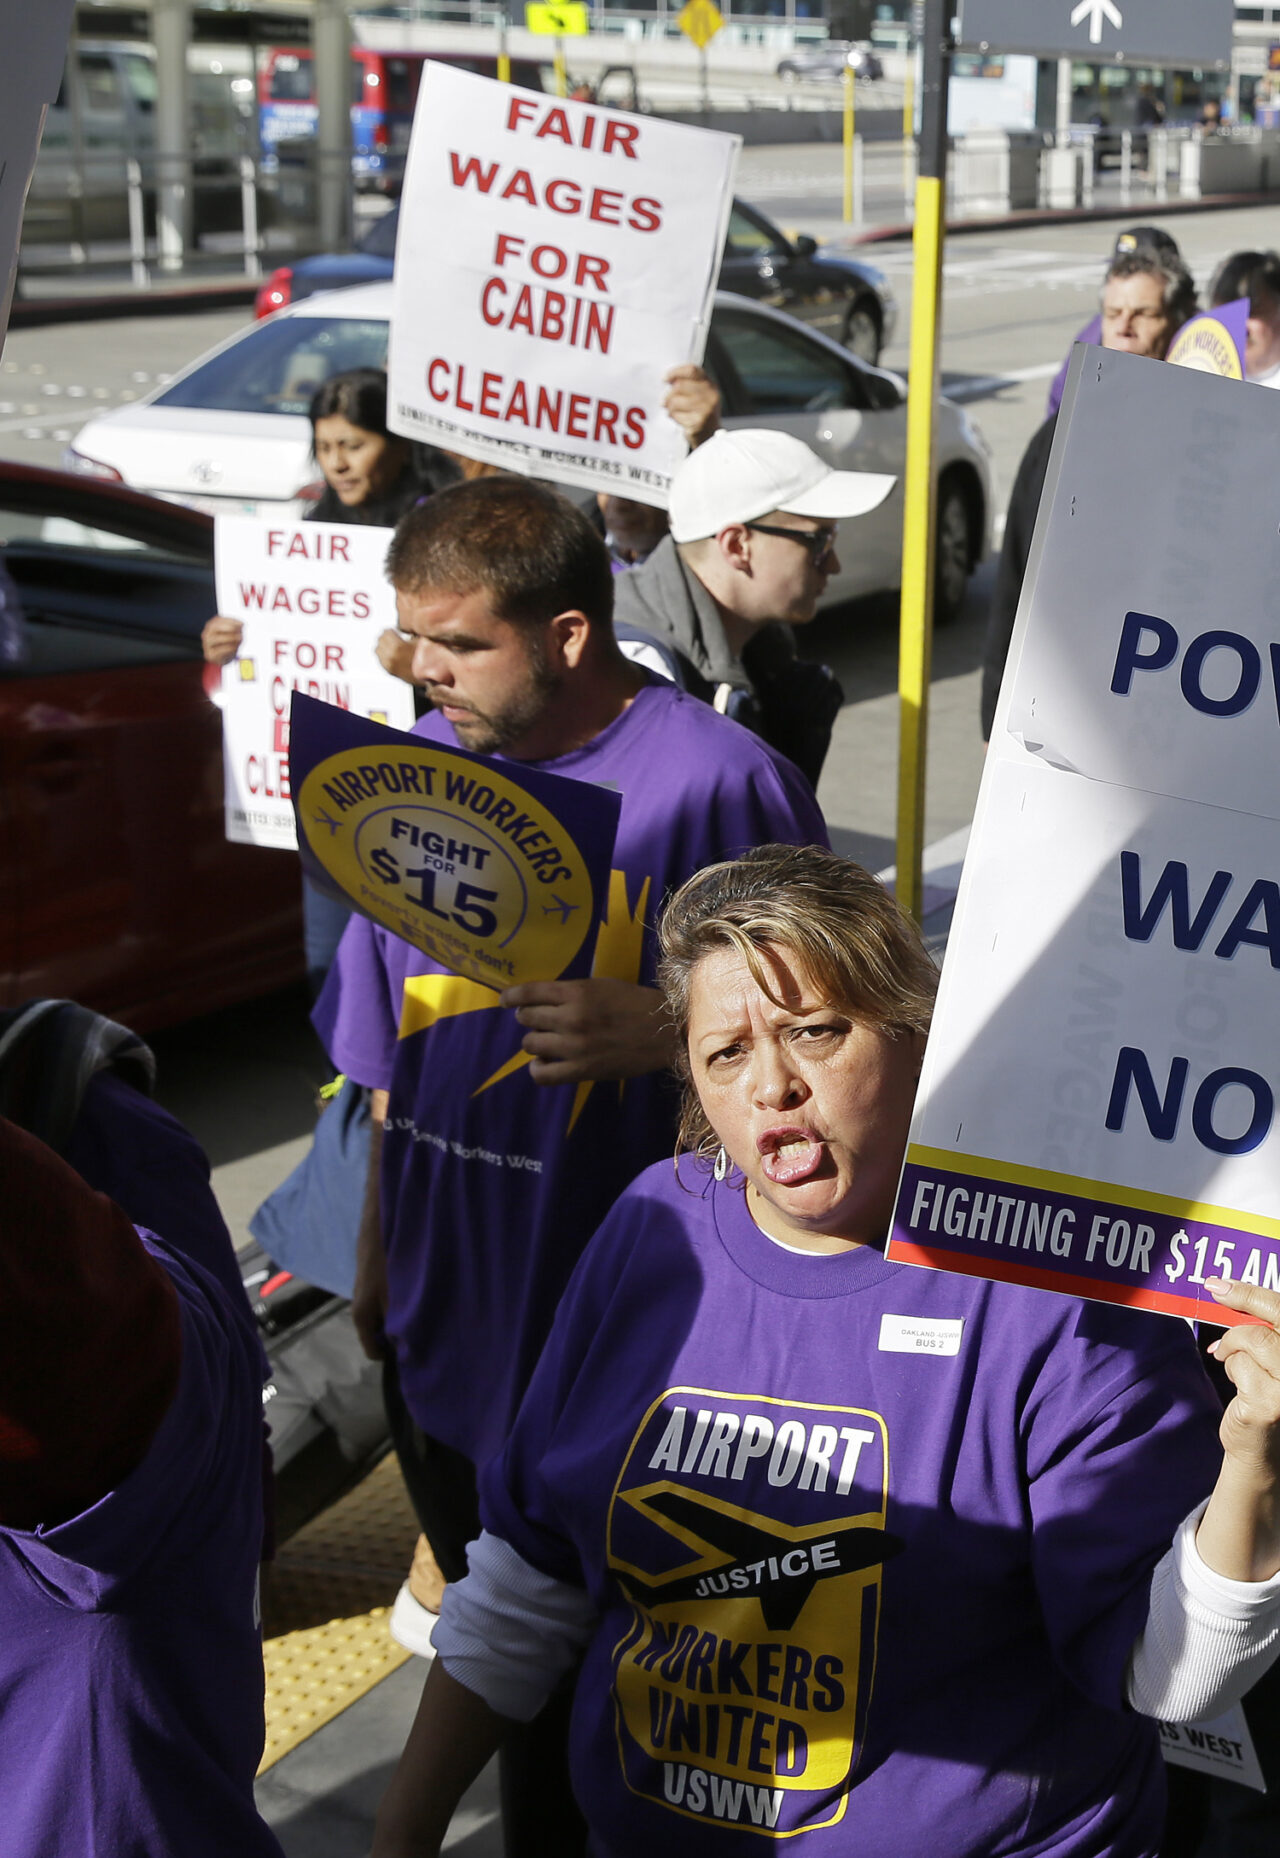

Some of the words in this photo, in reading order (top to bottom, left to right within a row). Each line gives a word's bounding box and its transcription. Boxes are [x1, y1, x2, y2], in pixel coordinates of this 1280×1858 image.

[506, 97, 640, 159] FAIR
[448, 152, 664, 232] WAGES
[494, 233, 610, 292] FOR
[481, 277, 615, 355] CABIN
[428, 358, 647, 449] CLEANERS
[540, 448, 622, 475] WORKERS
[629, 466, 672, 489] WEST
[267, 530, 350, 562] FAIR
[239, 581, 371, 619] WAGES
[274, 640, 345, 672] FOR
[321, 762, 437, 812] AIRPORT
[445, 770, 572, 885] WORKERS
[391, 817, 491, 871] FIGHT
[369, 847, 498, 938] $15
[424, 854, 456, 875] FOR
[475, 948, 515, 977] don't
[909, 1180, 1076, 1259] FIGHTING
[1084, 1214, 1156, 1275] FOR
[1164, 1228, 1237, 1285] $15
[901, 1329, 935, 1338] OAKLAND
[916, 1338, 936, 1348] BUS
[938, 1340, 945, 1348] 2
[648, 1405, 875, 1497] AIRPORT
[694, 1540, 841, 1599] JUSTICE
[632, 1620, 845, 1713] WORKERS
[648, 1684, 809, 1777] UNITED
[1184, 1726, 1243, 1761] WEST
[663, 1762, 785, 1829] USWW
